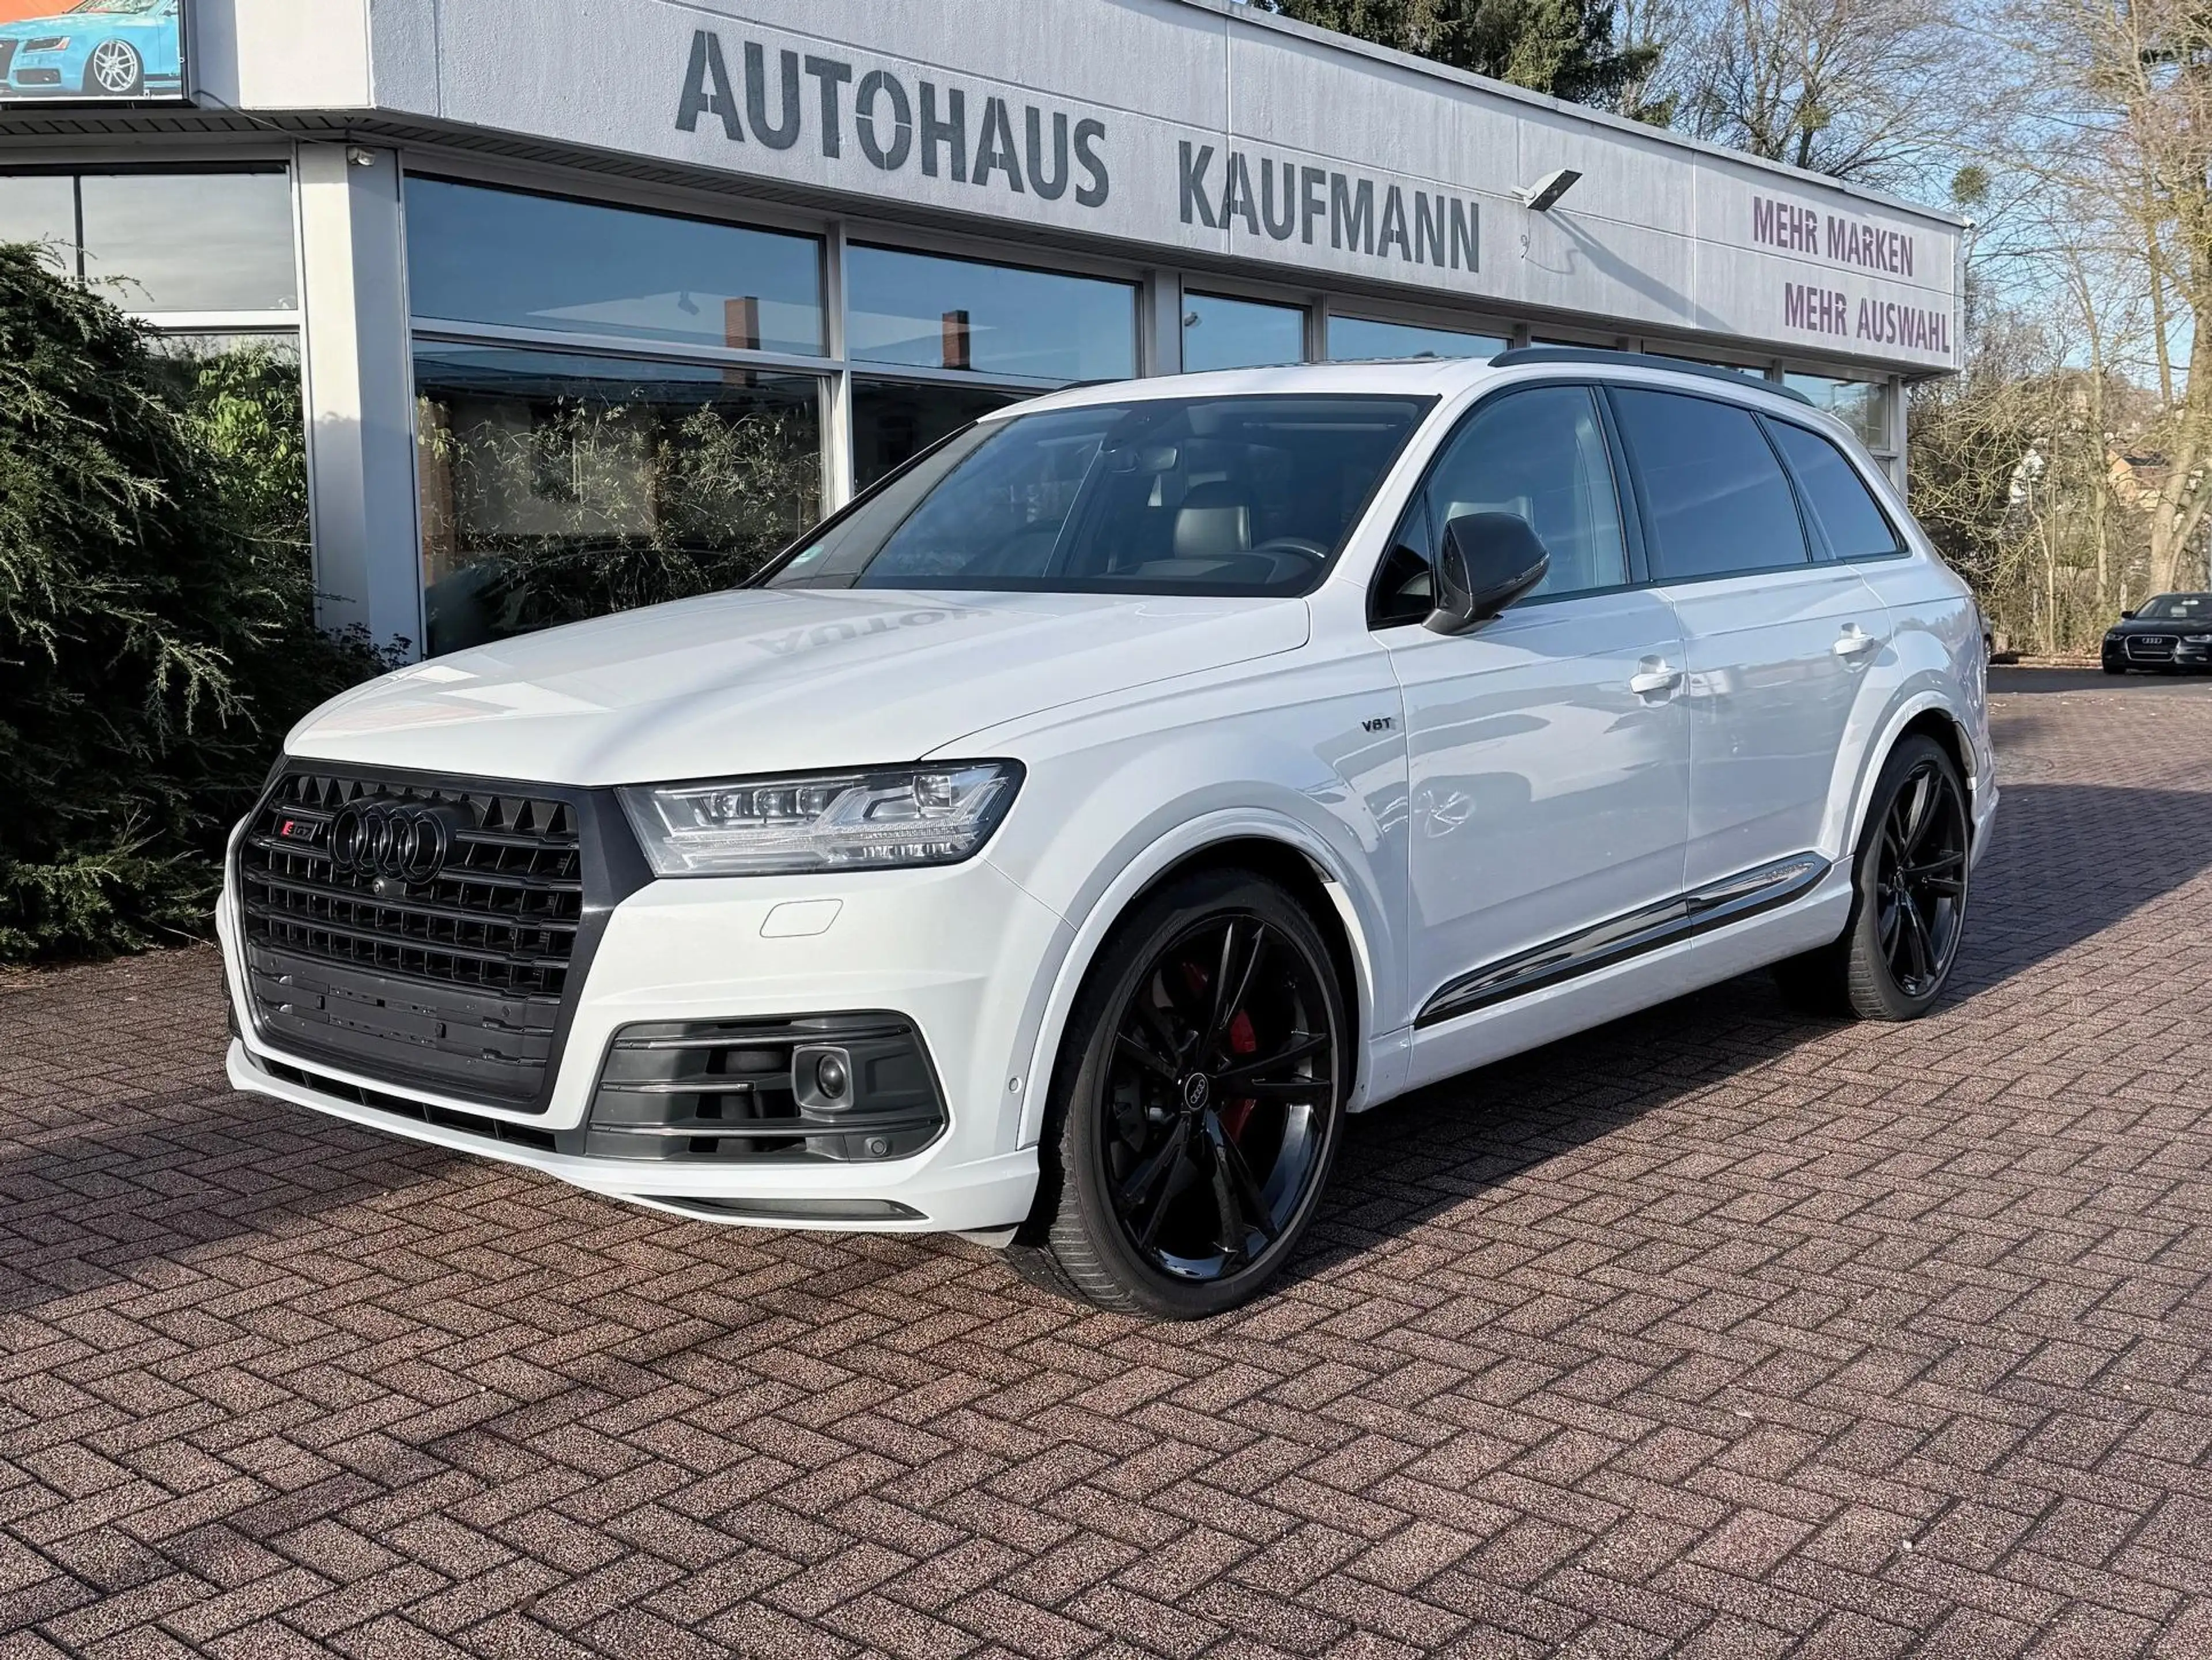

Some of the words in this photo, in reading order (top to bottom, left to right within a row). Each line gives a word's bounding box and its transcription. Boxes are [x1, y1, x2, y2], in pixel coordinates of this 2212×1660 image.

[675, 29, 1109, 208] AUTOHAUS
[1179, 140, 1479, 273] KAUFMANN
[1754, 196, 1818, 255] MEHR
[1828, 216, 1913, 277] MARKEN
[1785, 282, 1847, 335] MEHR
[1856, 297, 1950, 353] AUSWAHL
